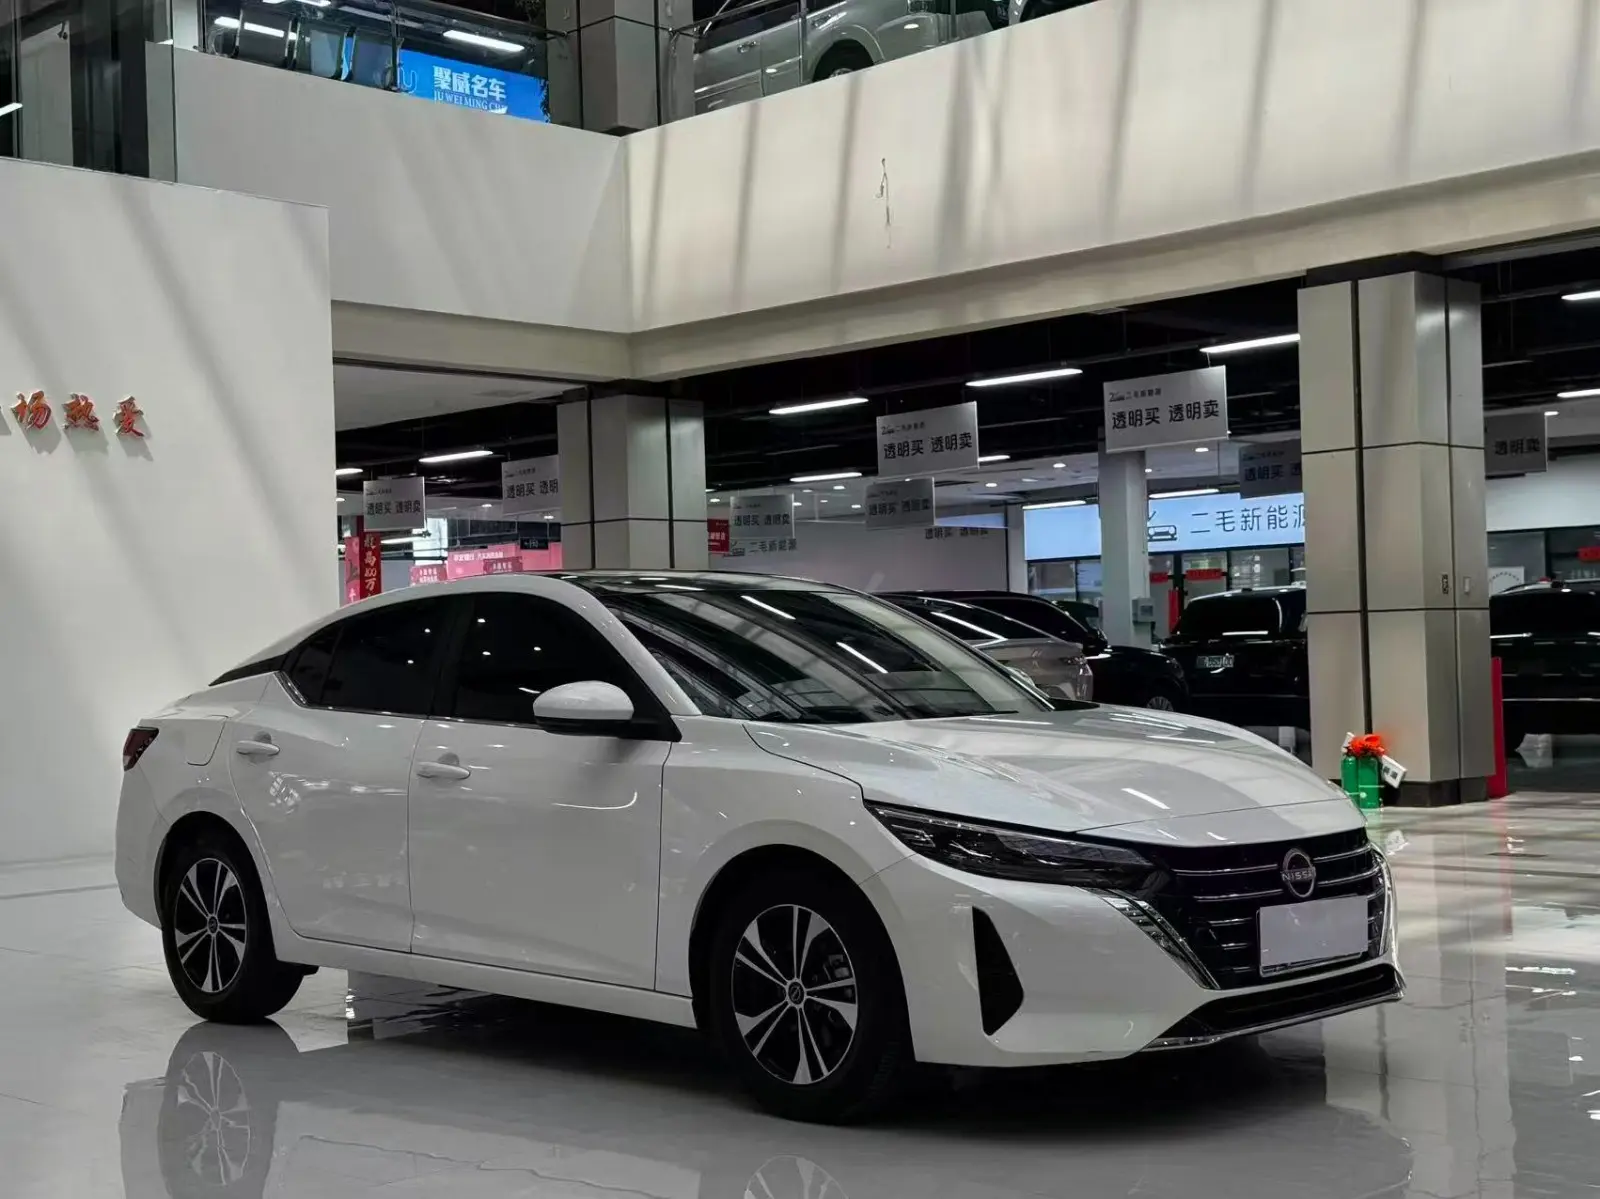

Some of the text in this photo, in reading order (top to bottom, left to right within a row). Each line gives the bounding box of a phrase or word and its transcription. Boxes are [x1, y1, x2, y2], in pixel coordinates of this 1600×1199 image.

[433, 65, 506, 101] 聚威名车
[1112, 399, 1220, 430] 透明买 透明卖
[884, 432, 973, 460] 透明买 透明卖
[1281, 867, 1316, 882] NISS
